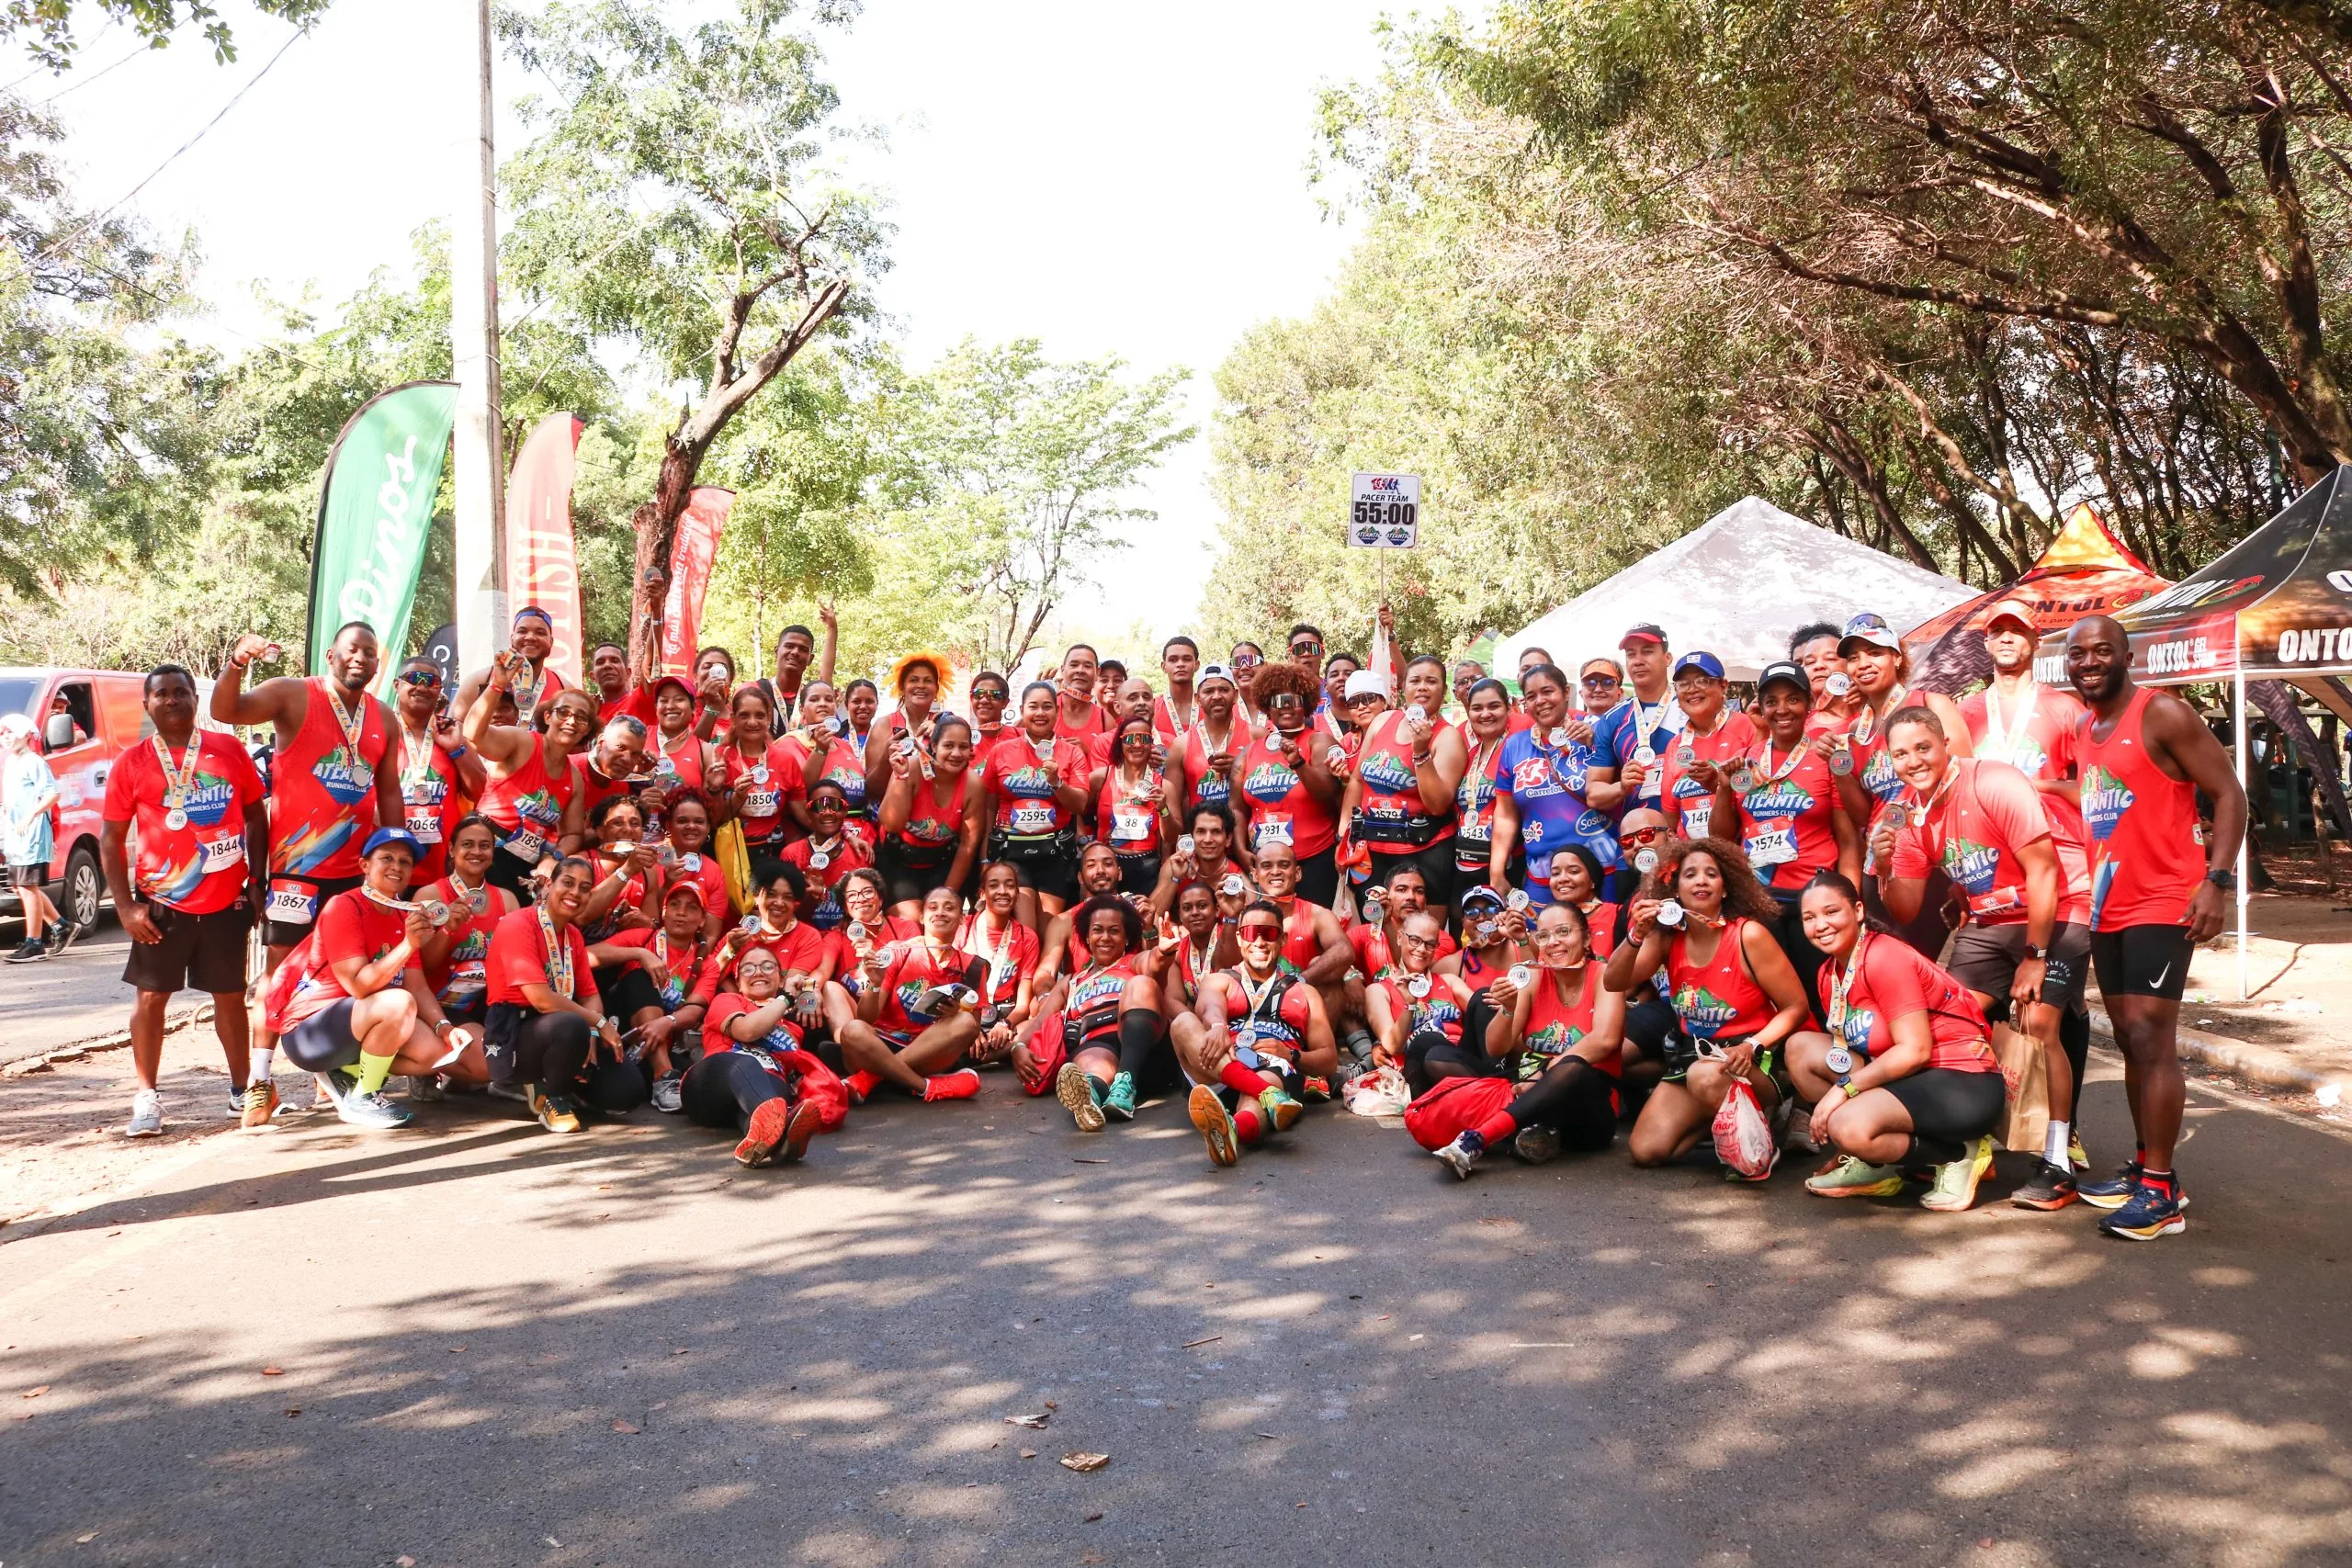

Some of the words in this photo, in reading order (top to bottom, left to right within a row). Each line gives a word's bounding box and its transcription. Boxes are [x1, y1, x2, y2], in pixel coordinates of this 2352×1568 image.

[1354, 502, 1415, 525] 55:00
[339, 434, 418, 637] Pinos
[326, 782, 355, 791] RUNNERS
[1244, 773, 1300, 790] ATLANTIC
[1385, 783, 1401, 791] CLUB
[1891, 778, 1905, 787] CLUB
[1527, 783, 1564, 797] Carrefou
[747, 794, 772, 805] 1850
[1742, 793, 1815, 809] ATLANTIC
[211, 801, 227, 810] CLUB
[1020, 811, 1046, 821] 2595
[1753, 809, 1779, 818] RUNNERS
[1780, 809, 1797, 818] CLUB
[2103, 812, 2118, 821] CLUB
[406, 819, 436, 830] 2066
[1125, 818, 1137, 827] 88
[1264, 825, 1280, 835] 931
[211, 839, 238, 857] 1844
[1755, 834, 1781, 852] 1574
[1975, 868, 1993, 879] CLUB
[277, 895, 306, 908] 1867
[773, 1039, 786, 1050] CLUB
